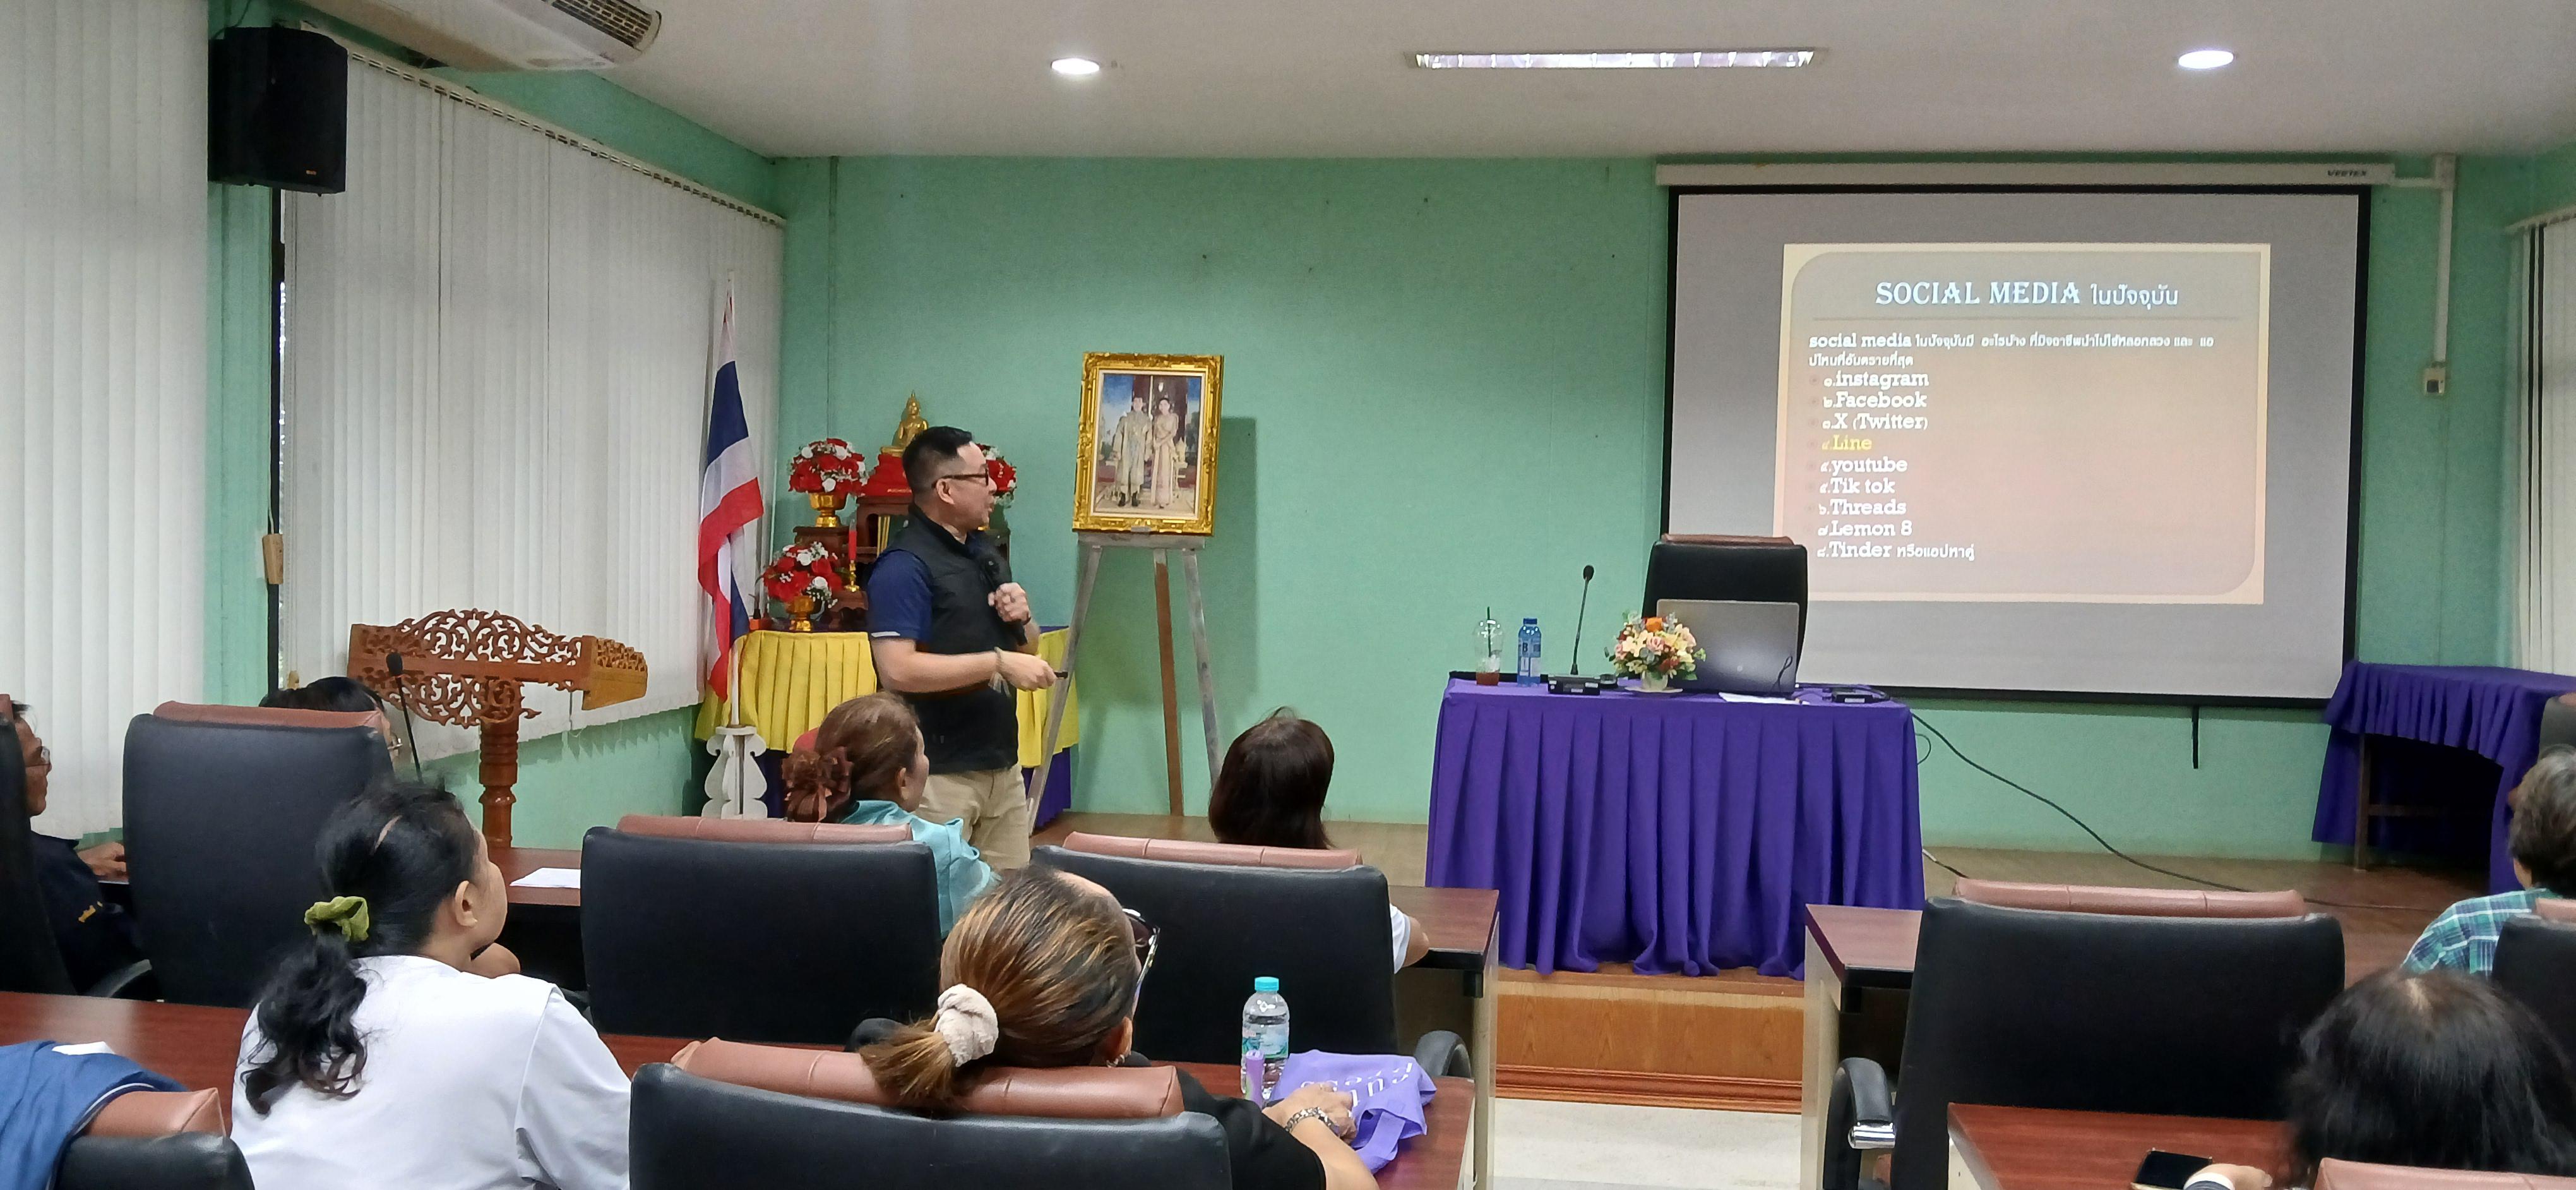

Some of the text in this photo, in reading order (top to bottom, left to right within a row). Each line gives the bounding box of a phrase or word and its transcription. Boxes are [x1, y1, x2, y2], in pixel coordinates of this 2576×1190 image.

[1875, 282, 2178, 310] SOCIAL MEDIA ในปัจจุบัน
[1809, 333, 1857, 348] social
[1861, 332, 1912, 348] media
[1916, 334, 1974, 350] ในปัจจุบันมี
[1981, 334, 2026, 347] อะไรบ้าง
[2174, 337, 2193, 347] และ
[2200, 337, 2214, 347] แอ
[1808, 351, 1914, 368] ปไหนที่อันตรายที่สุด
[1852, 412, 1928, 430] (Twitter)
[1864, 477, 1896, 494] tok
[1900, 520, 1913, 536] 8
[1897, 543, 1975, 562] หรือแอปหาคู่
